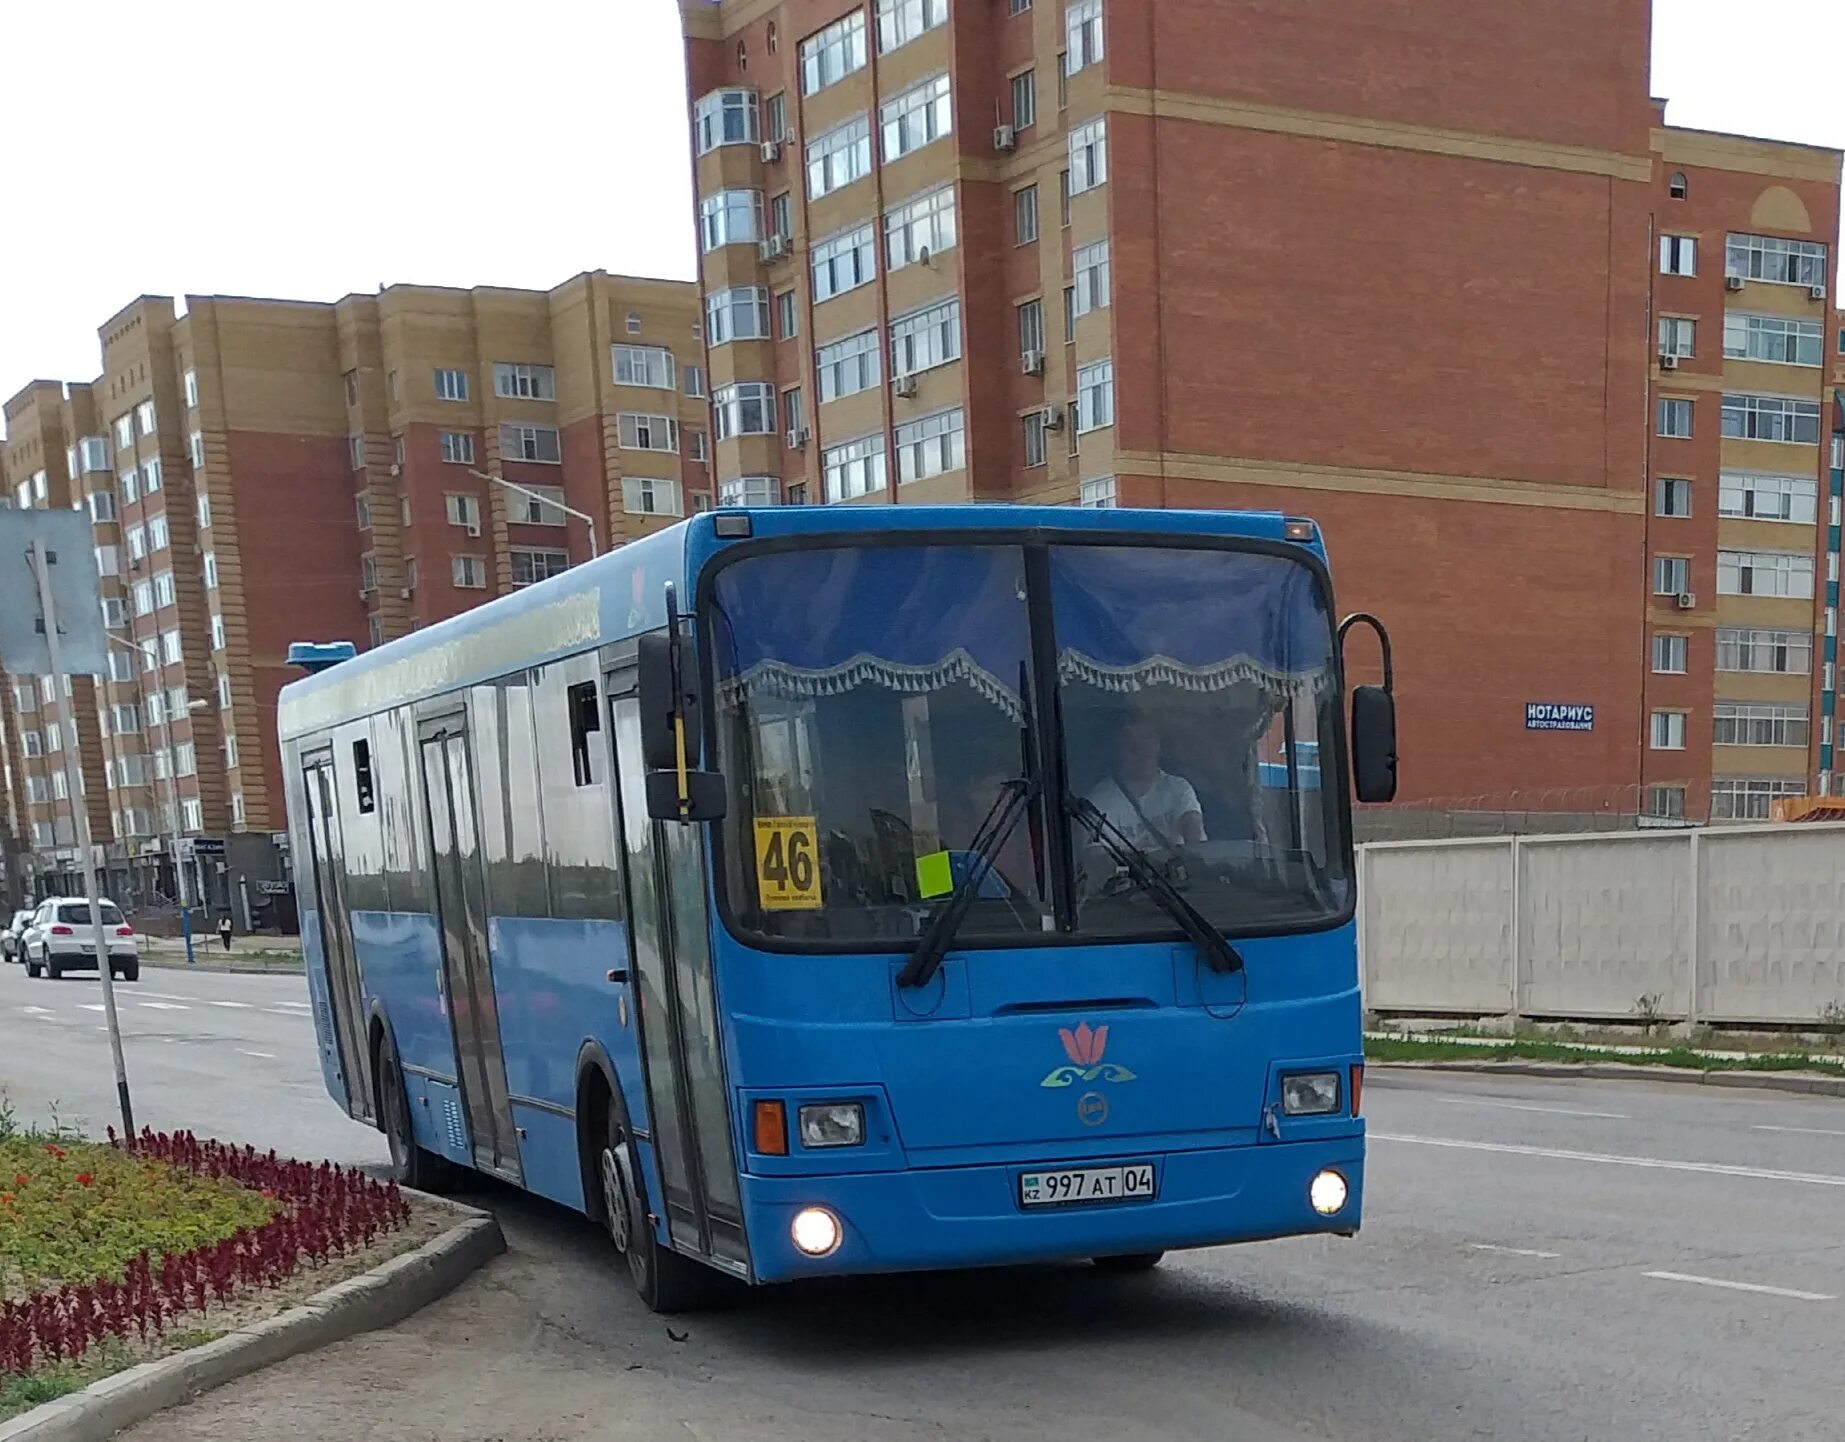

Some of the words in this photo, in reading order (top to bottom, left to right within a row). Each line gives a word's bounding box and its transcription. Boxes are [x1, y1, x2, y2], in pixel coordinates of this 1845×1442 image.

[1527, 704, 1592, 721] НОТАРИУС
[763, 831, 813, 892] 46
[1024, 1189, 1040, 1200] KZ
[1046, 1173, 1085, 1199] 997
[1092, 1176, 1117, 1195] AT
[1125, 1169, 1151, 1192] 04
